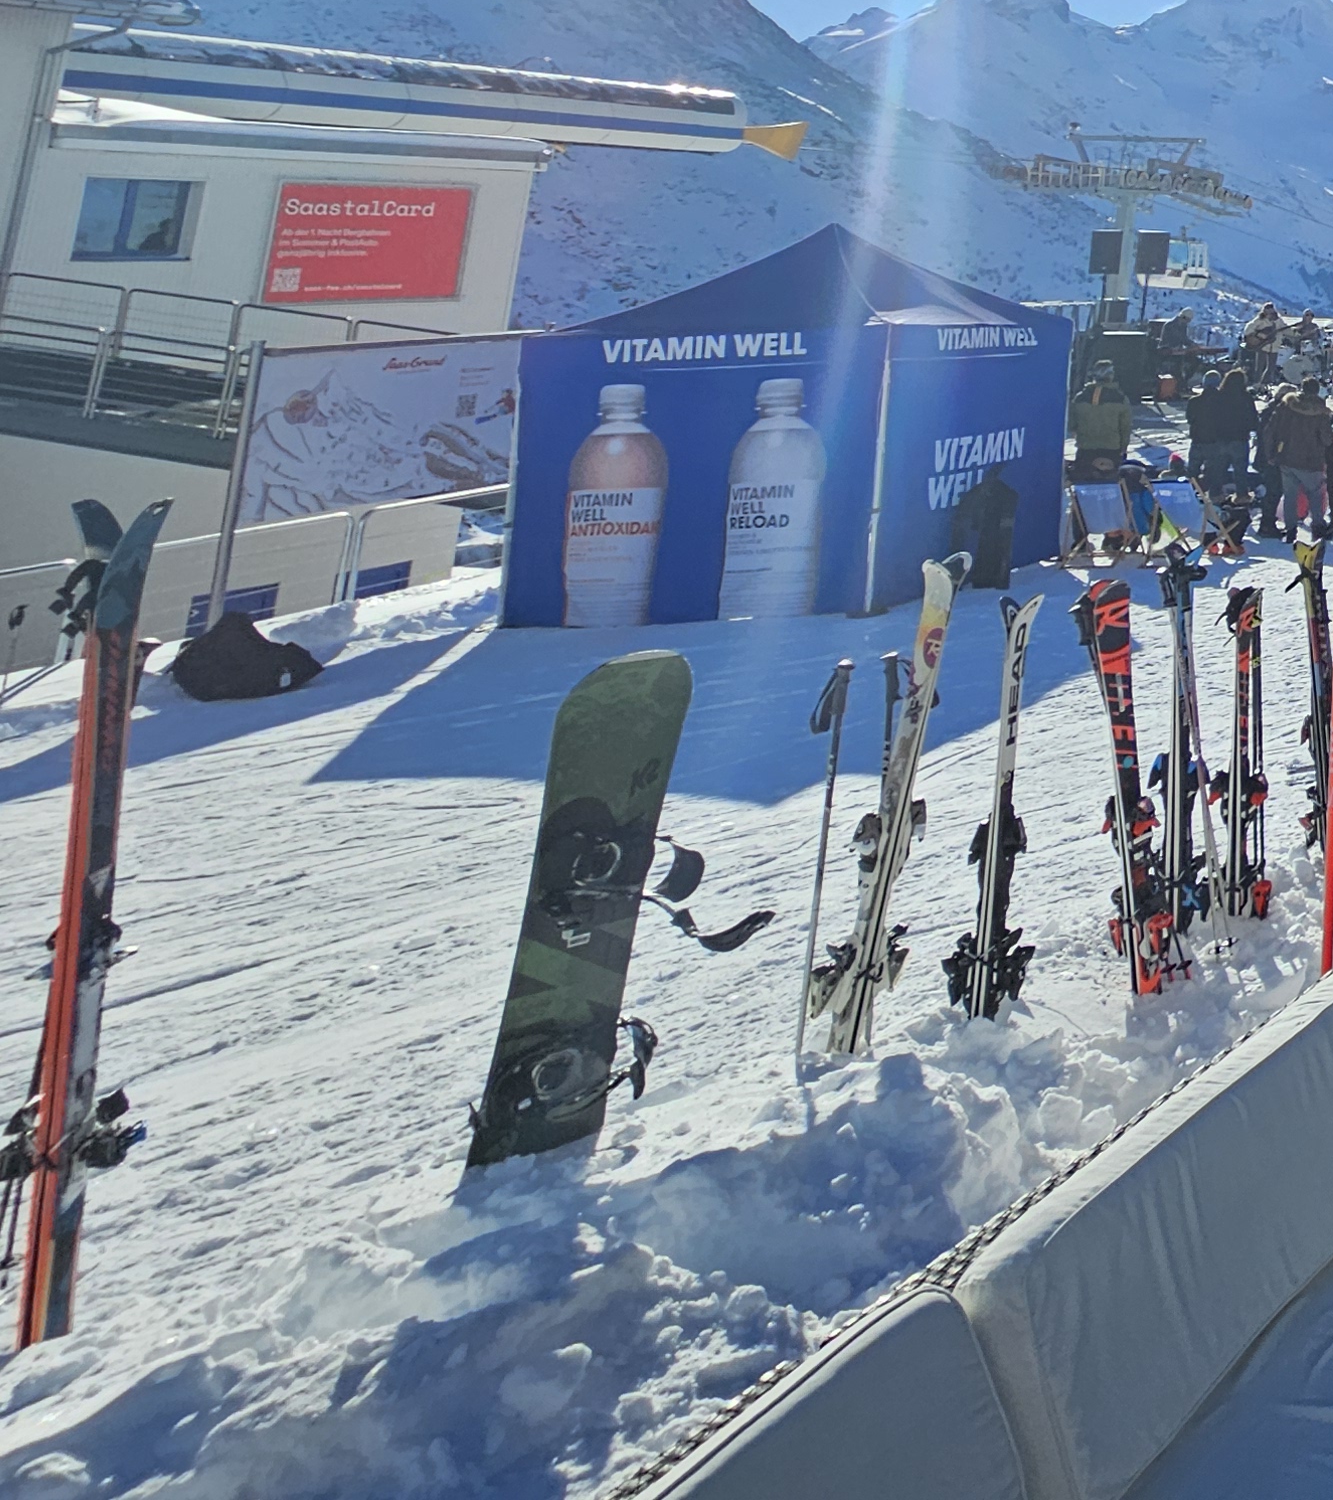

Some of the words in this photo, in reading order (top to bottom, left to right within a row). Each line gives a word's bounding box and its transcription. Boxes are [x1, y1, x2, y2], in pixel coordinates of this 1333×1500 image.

[285, 198, 436, 217] SaastalCard
[602, 334, 726, 364] VITAMIN
[734, 331, 808, 358] WELL
[937, 327, 1001, 352] VITAMIN
[1003, 327, 1039, 348] WELL
[934, 426, 1027, 473] VITAMIN
[573, 492, 634, 509] VITAMIN
[732, 484, 796, 501] VITAMIN
[571, 507, 608, 523] WELL
[730, 500, 766, 516] WELL
[729, 514, 790, 530] RELOAD
[1006, 622, 1027, 747] HEAD
